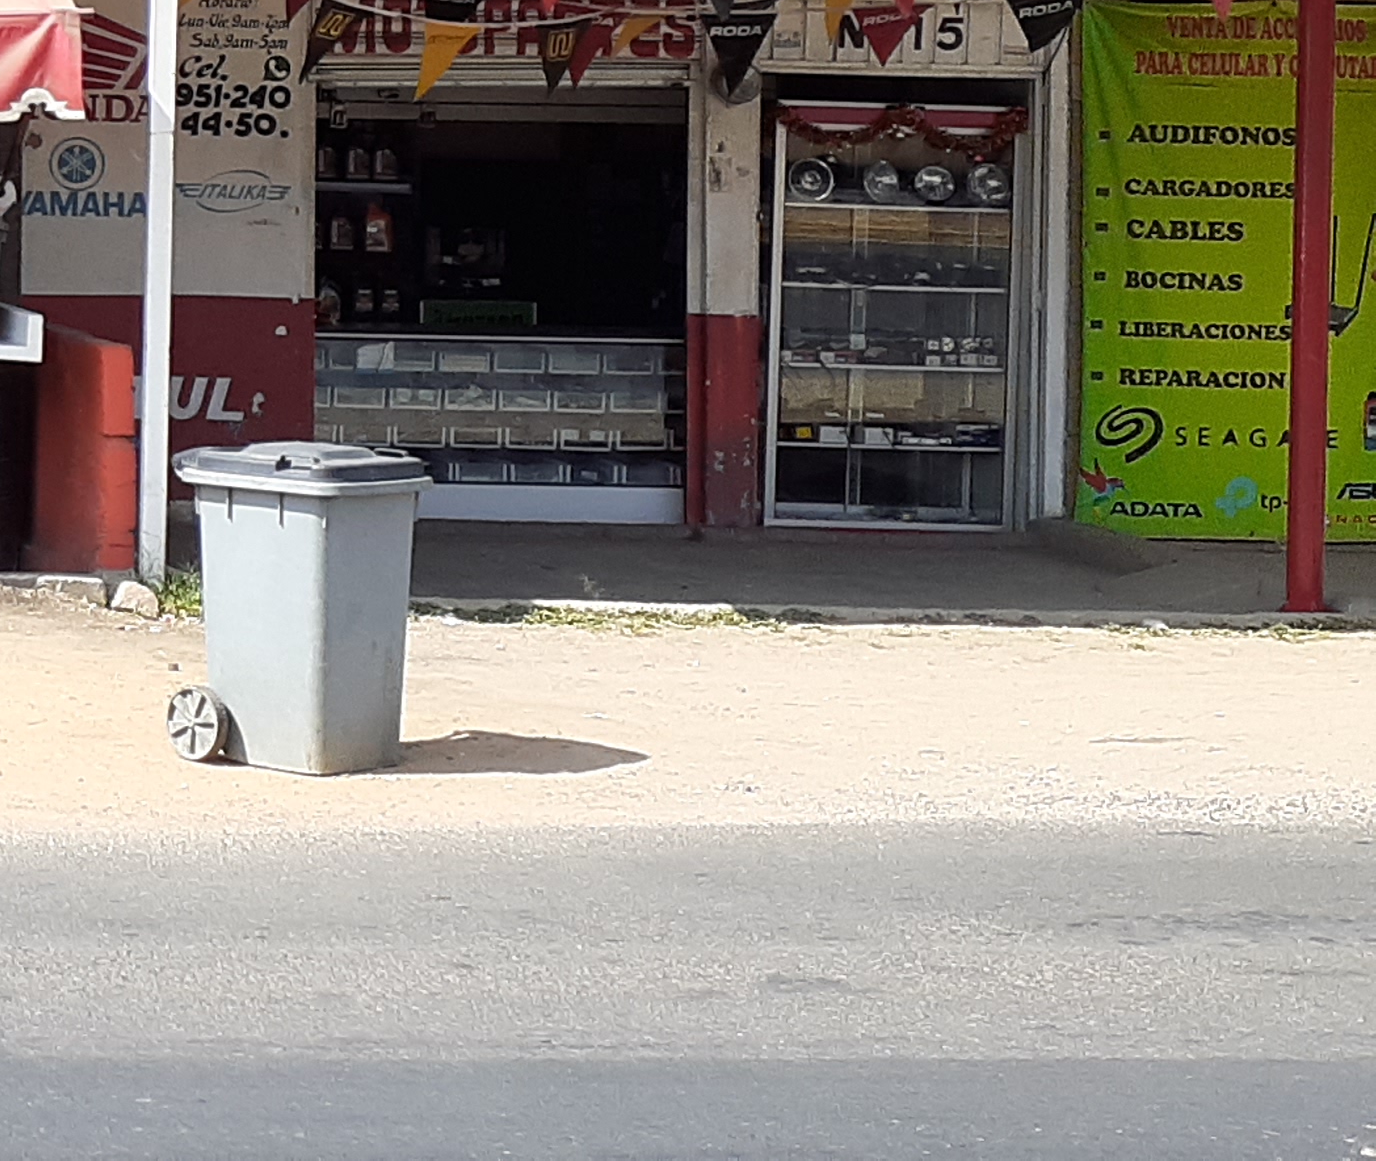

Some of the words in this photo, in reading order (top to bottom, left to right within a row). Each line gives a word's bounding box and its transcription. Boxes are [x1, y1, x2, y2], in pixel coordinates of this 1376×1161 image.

[1018, 0, 1074, 19] RODA
[709, 25, 763, 37] RODA
[1166, 15, 1231, 39] VENTA
[1234, 16, 1257, 39] DE
[179, 56, 229, 82] Cel.
[1135, 51, 1183, 75] PARA
[1188, 52, 1270, 77] CELULAR
[1273, 53, 1286, 77] Y
[1126, 123, 1297, 146] AUDIFONOS
[1124, 179, 1296, 200] CARGADORES
[1126, 219, 1244, 241] CABLES
[1124, 270, 1244, 291] BOCINAS
[1118, 320, 1292, 341] LIBERACIONES
[1118, 368, 1286, 389] REPARACION
[168, 376, 245, 422] UL
[1174, 426, 1340, 449] SEAGAE
[1109, 501, 1203, 518] ADATA
